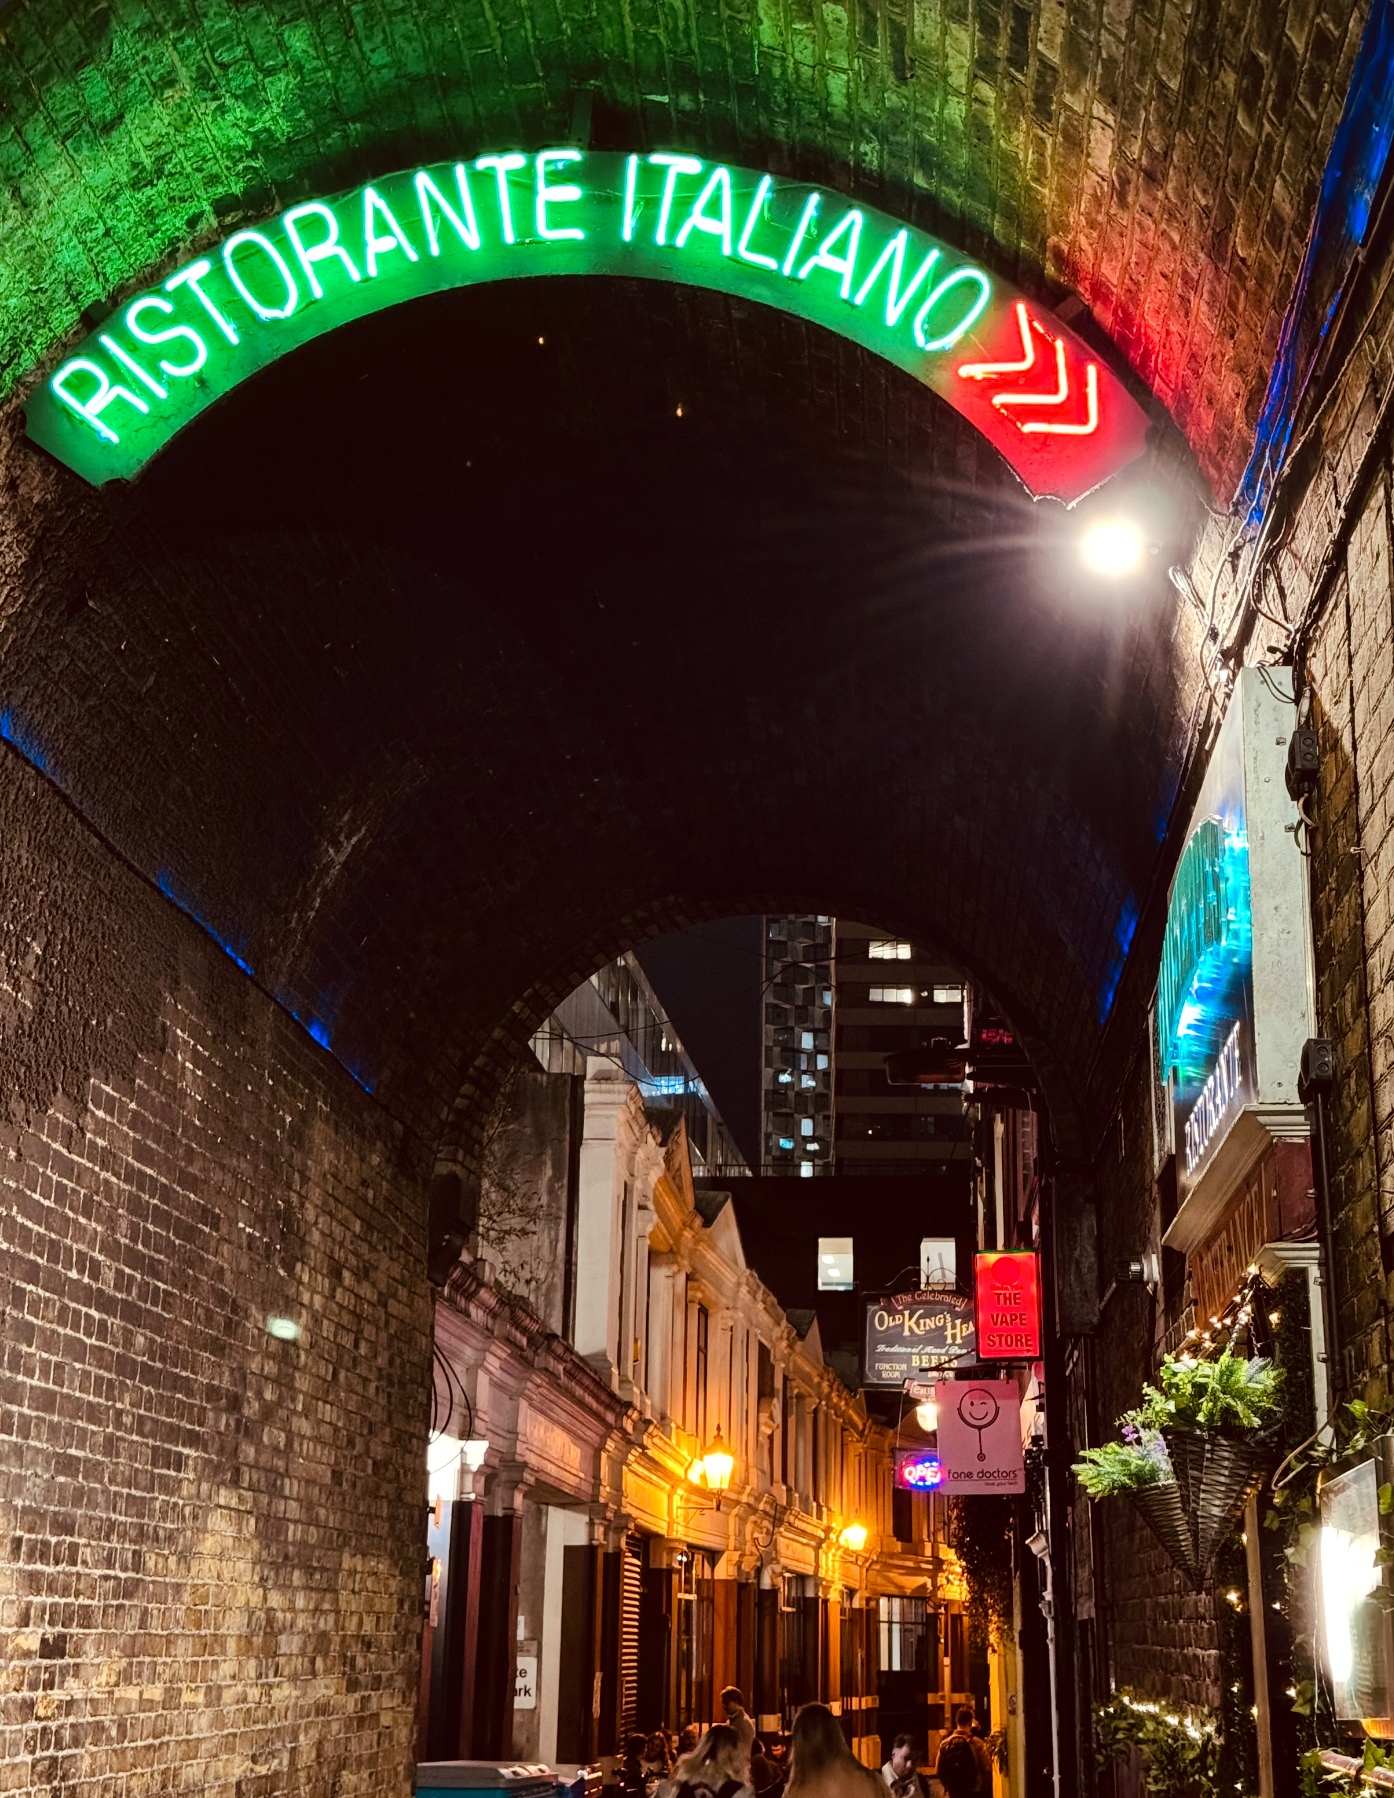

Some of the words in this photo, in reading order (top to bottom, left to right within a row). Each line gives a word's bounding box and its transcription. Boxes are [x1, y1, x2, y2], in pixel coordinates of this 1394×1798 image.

[51, 148, 586, 443] RISTORANTE
[622, 152, 992, 352] ITALIANO
[897, 1294, 912, 1304] The
[914, 1290, 963, 1305] Celebrated
[994, 1292, 1022, 1306] THE
[990, 1312, 1028, 1327] VAPE
[874, 1310, 903, 1331] OLD
[944, 1318, 976, 1345] HEA
[986, 1333, 1034, 1348] STORE
[875, 1344, 923, 1354] Traditional
[875, 1362, 907, 1372] FUNCTION
[911, 1355, 958, 1368] BEERS
[882, 1370, 901, 1379] ROOM
[947, 1468, 973, 1480] fone
[976, 1468, 1018, 1479] doctors
